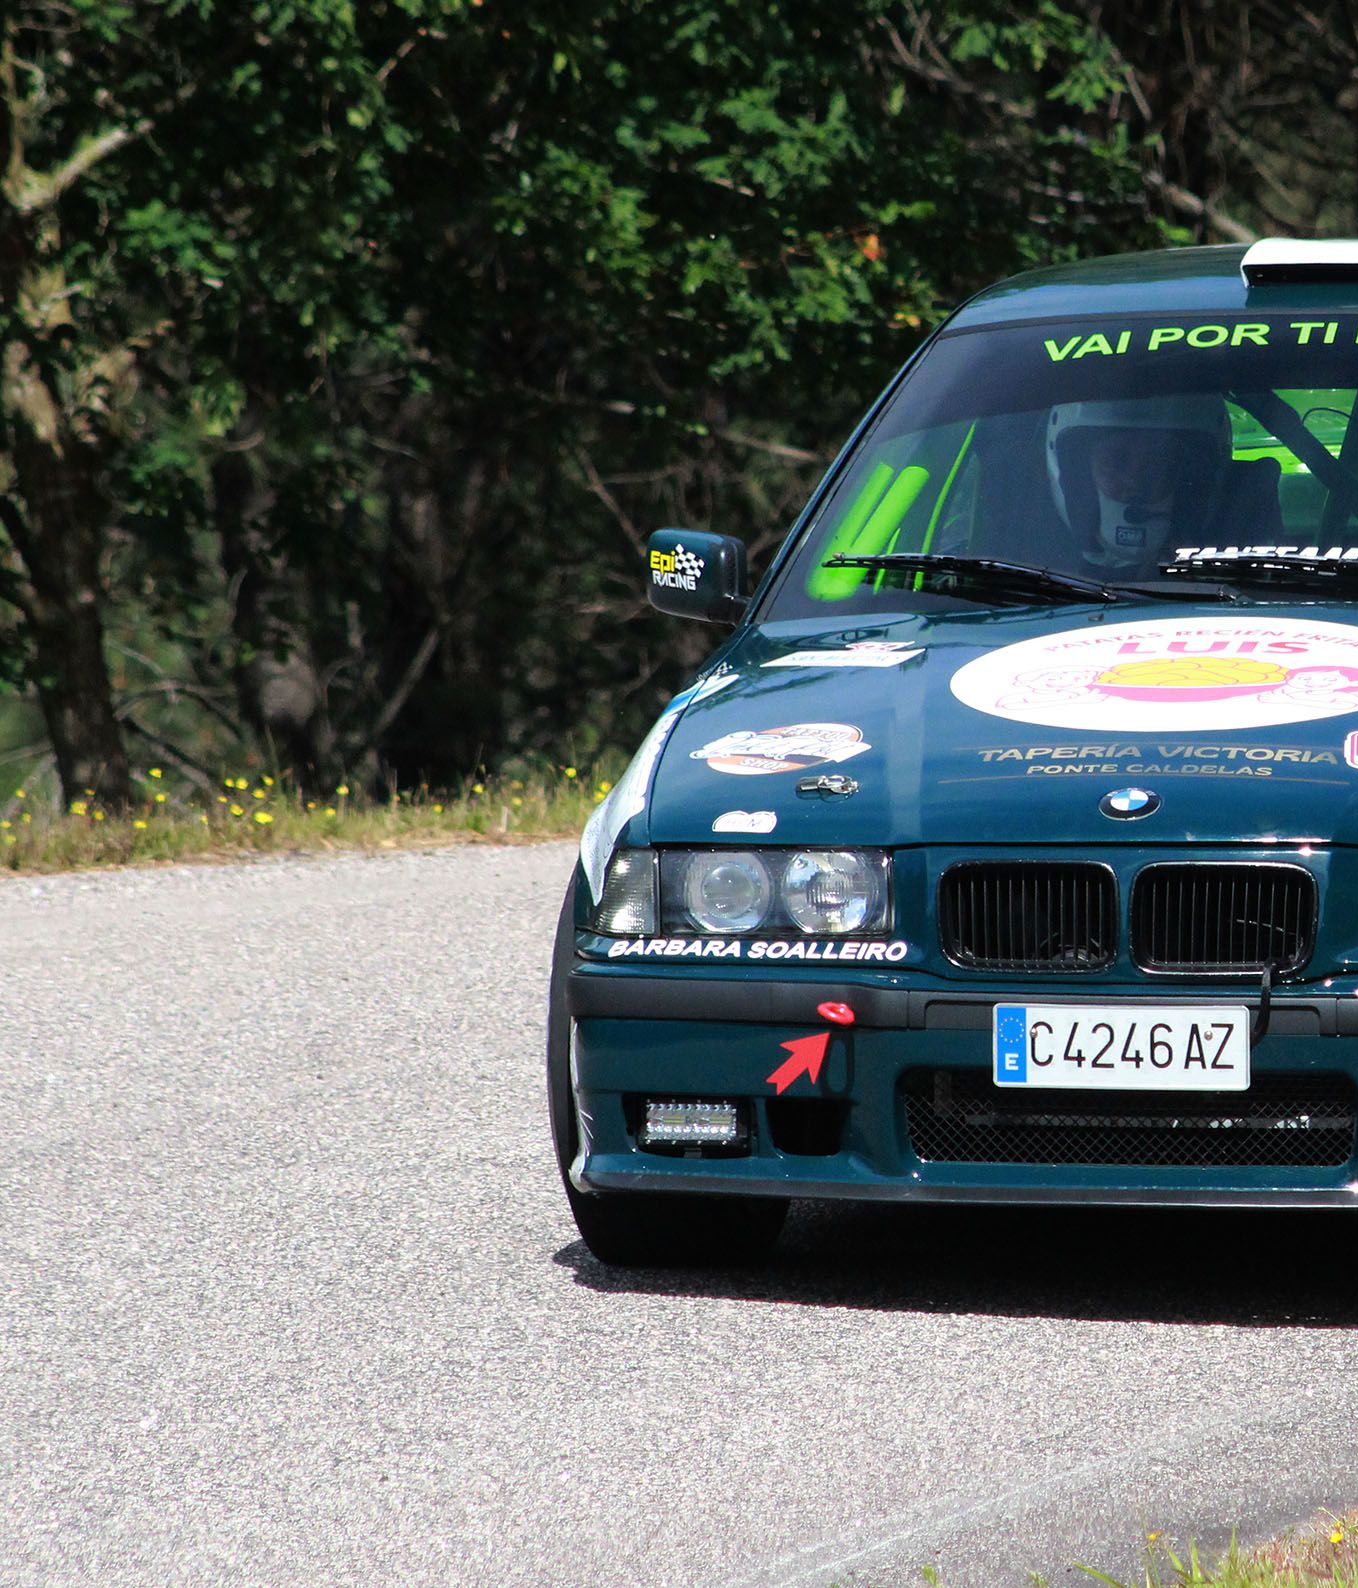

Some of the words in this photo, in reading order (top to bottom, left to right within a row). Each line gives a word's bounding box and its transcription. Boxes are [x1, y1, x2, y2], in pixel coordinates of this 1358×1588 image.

[1043, 330, 1131, 362] VAI
[1148, 323, 1270, 351] POR
[1290, 321, 1339, 345] TI
[650, 550, 676, 578] Epi
[652, 571, 696, 591] RACING
[1044, 631, 1163, 653] PATATAS
[1116, 640, 1310, 655] LUIS
[740, 757, 790, 771] SHOP
[979, 744, 1142, 762] TAPERÍA
[1158, 745, 1338, 765] VICTORIA
[1026, 763, 1118, 775] PONTE
[1124, 763, 1273, 777] CALDELAS
[747, 940, 908, 961] SOALLEIRO
[1004, 1053, 1019, 1071] E
